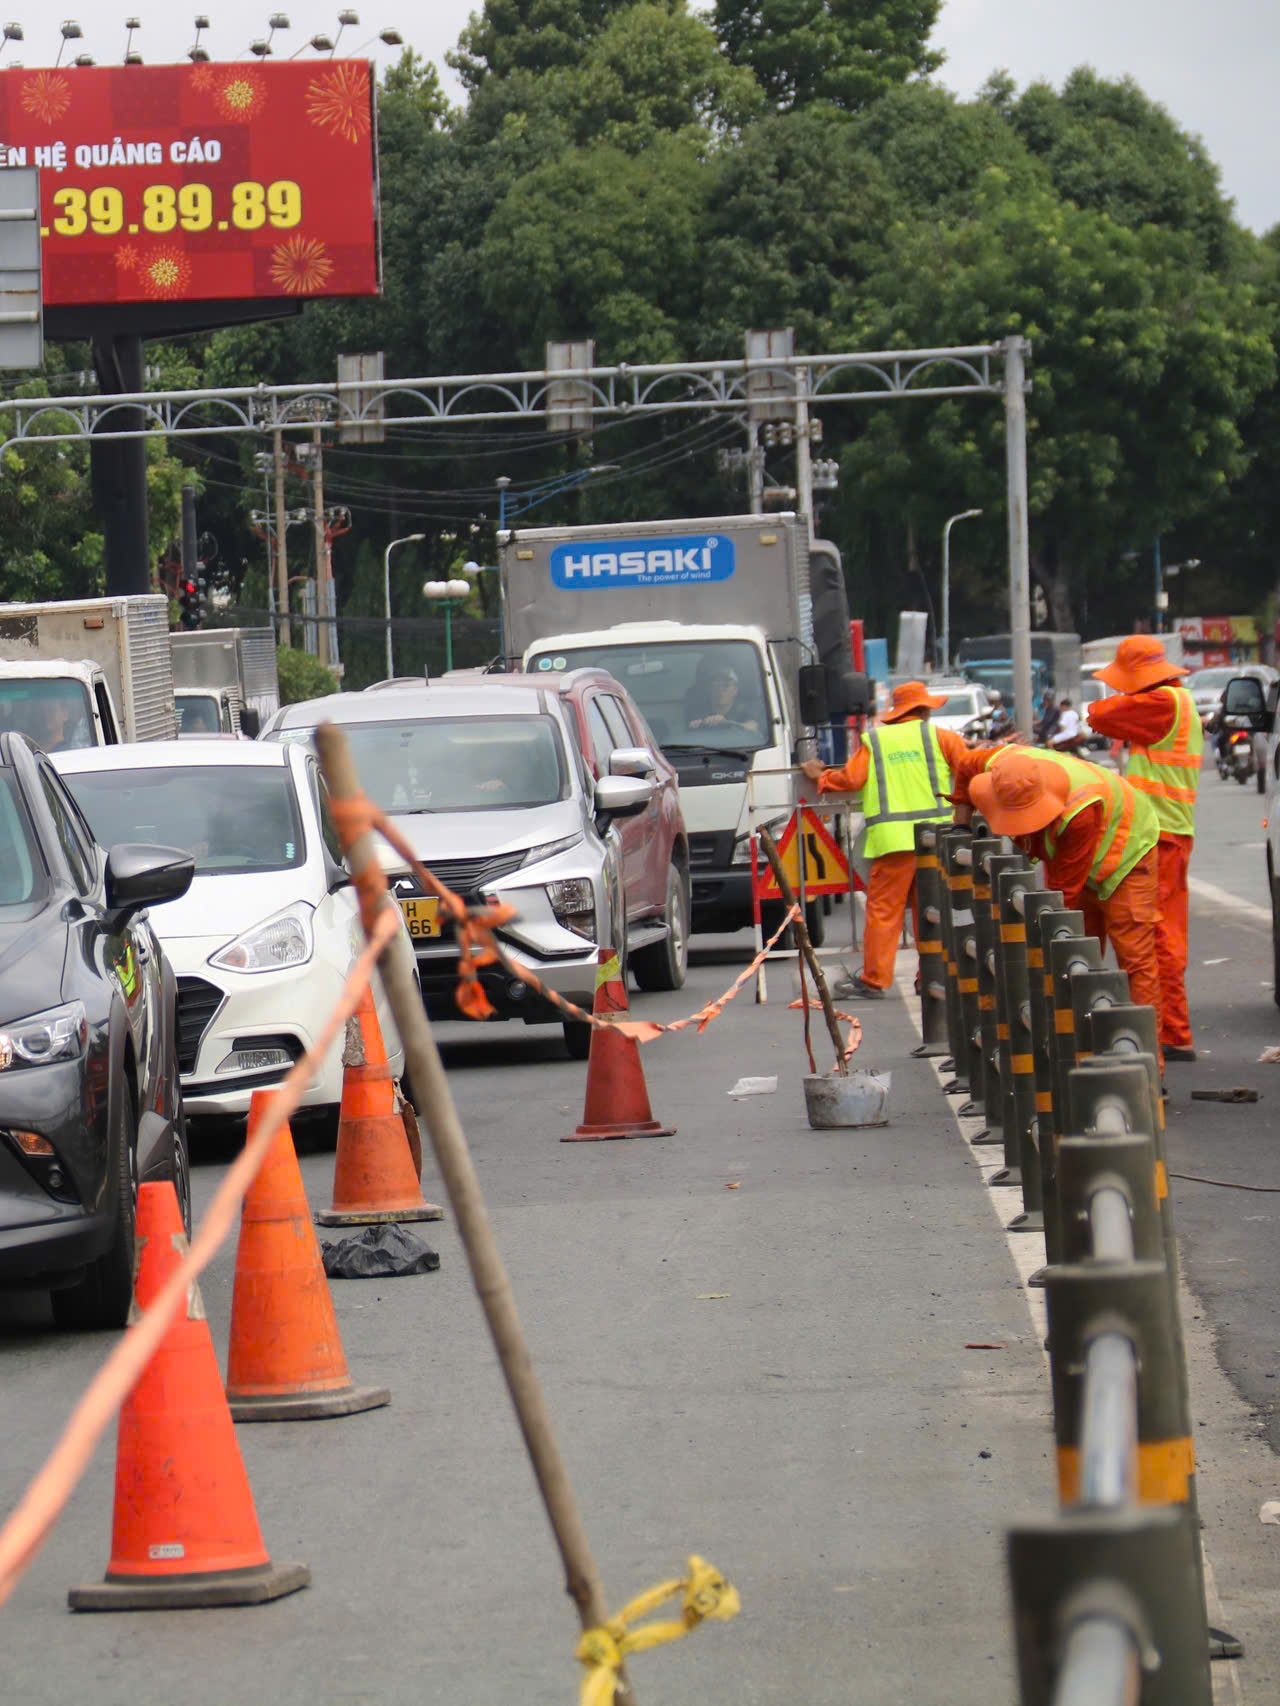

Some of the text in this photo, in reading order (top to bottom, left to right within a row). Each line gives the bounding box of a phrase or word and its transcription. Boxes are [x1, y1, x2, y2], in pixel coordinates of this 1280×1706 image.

[35, 140, 67, 172] HỆ
[74, 136, 162, 169] QUẢNG
[170, 136, 221, 163] CÁO
[637, 574, 651, 582] The
[654, 573, 679, 583] power
[690, 570, 711, 579] wind
